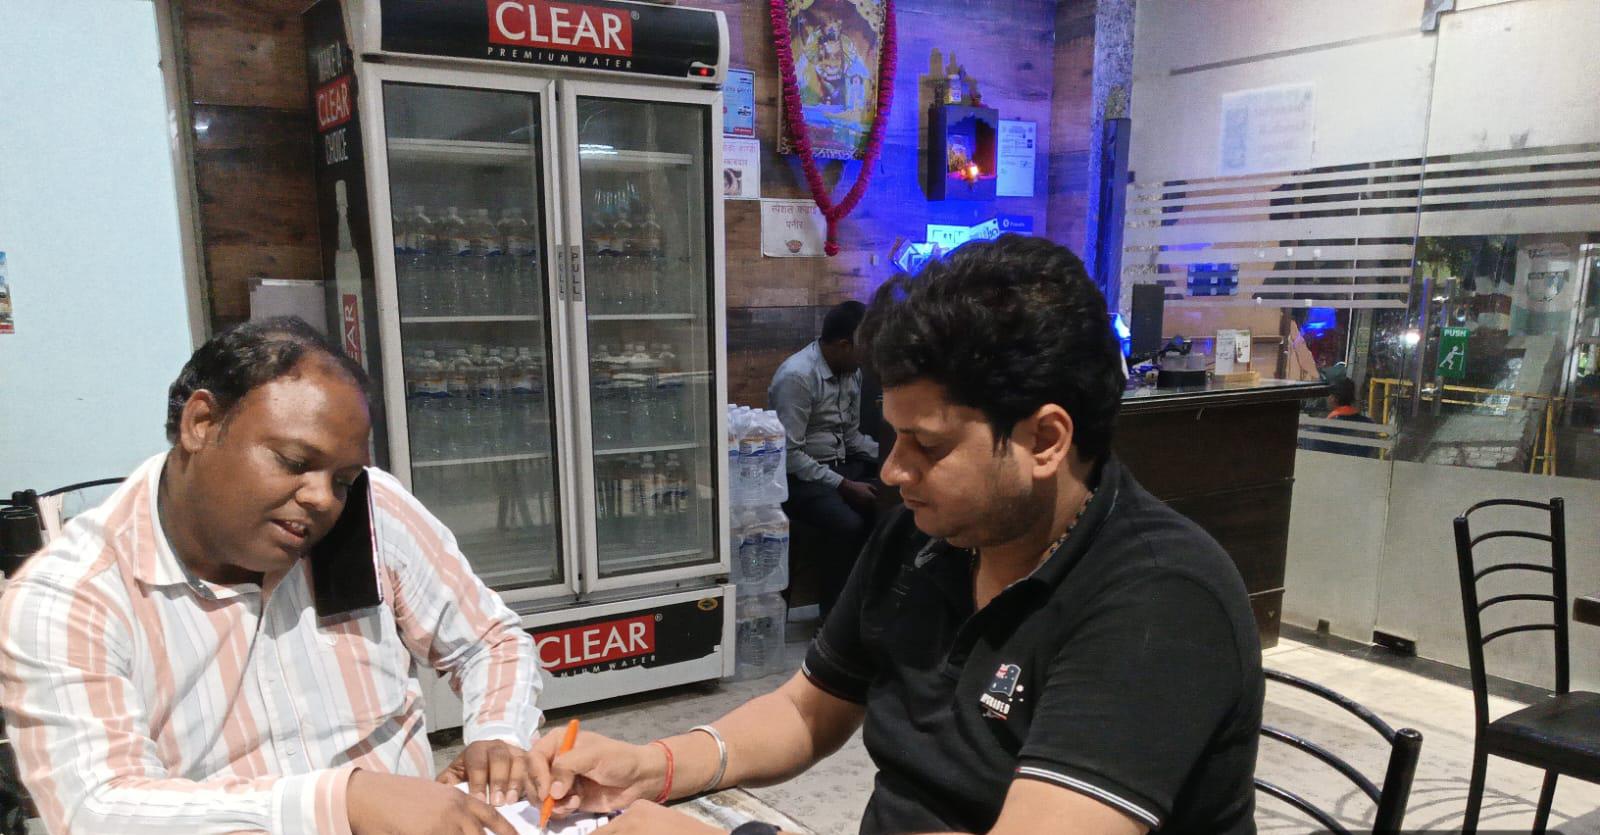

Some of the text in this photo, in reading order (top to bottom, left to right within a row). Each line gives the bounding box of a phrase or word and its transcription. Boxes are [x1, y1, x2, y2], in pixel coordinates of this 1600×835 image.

[495, 1, 626, 51] CLEAR
[487, 47, 632, 69] PREMIUM WATER
[319, 82, 350, 127] CLEAR
[571, 253, 580, 294] PULL
[1443, 329, 1467, 337] PUSH
[536, 622, 649, 668] CLEAR
[608, 655, 656, 670] WATER
